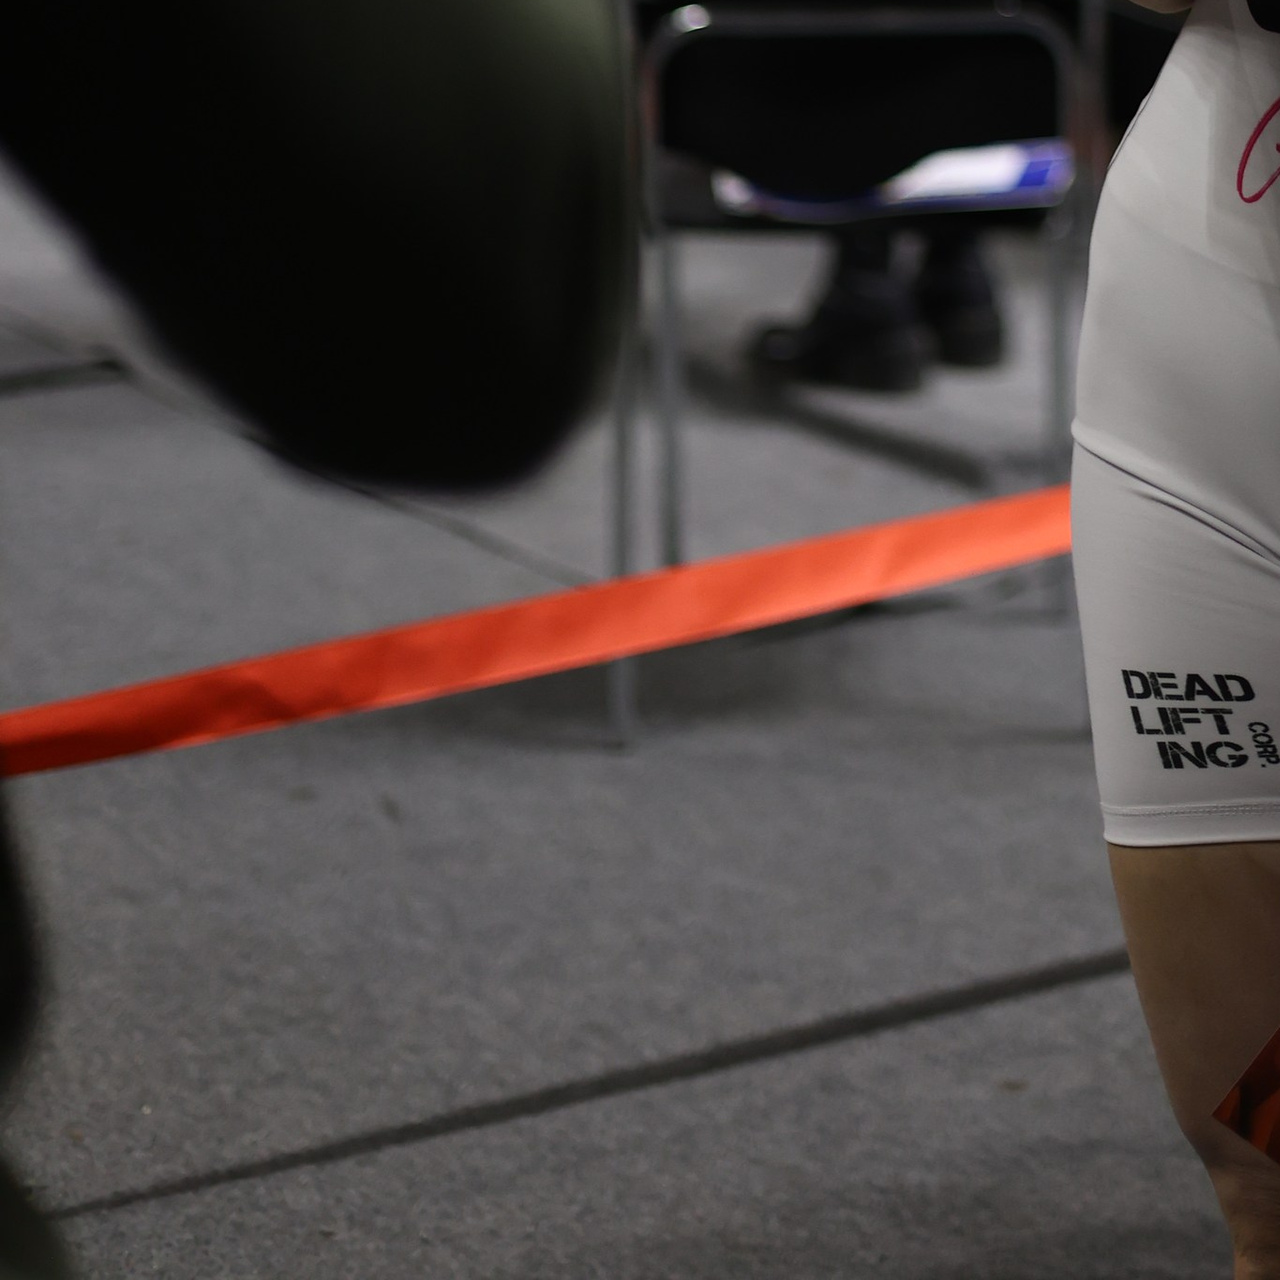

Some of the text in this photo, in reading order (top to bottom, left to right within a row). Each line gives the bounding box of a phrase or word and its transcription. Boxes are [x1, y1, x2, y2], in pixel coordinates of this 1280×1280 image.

[1121, 669, 1255, 702] DEAD
[1130, 706, 1233, 735] LIFT
[1157, 741, 1249, 769] ING
